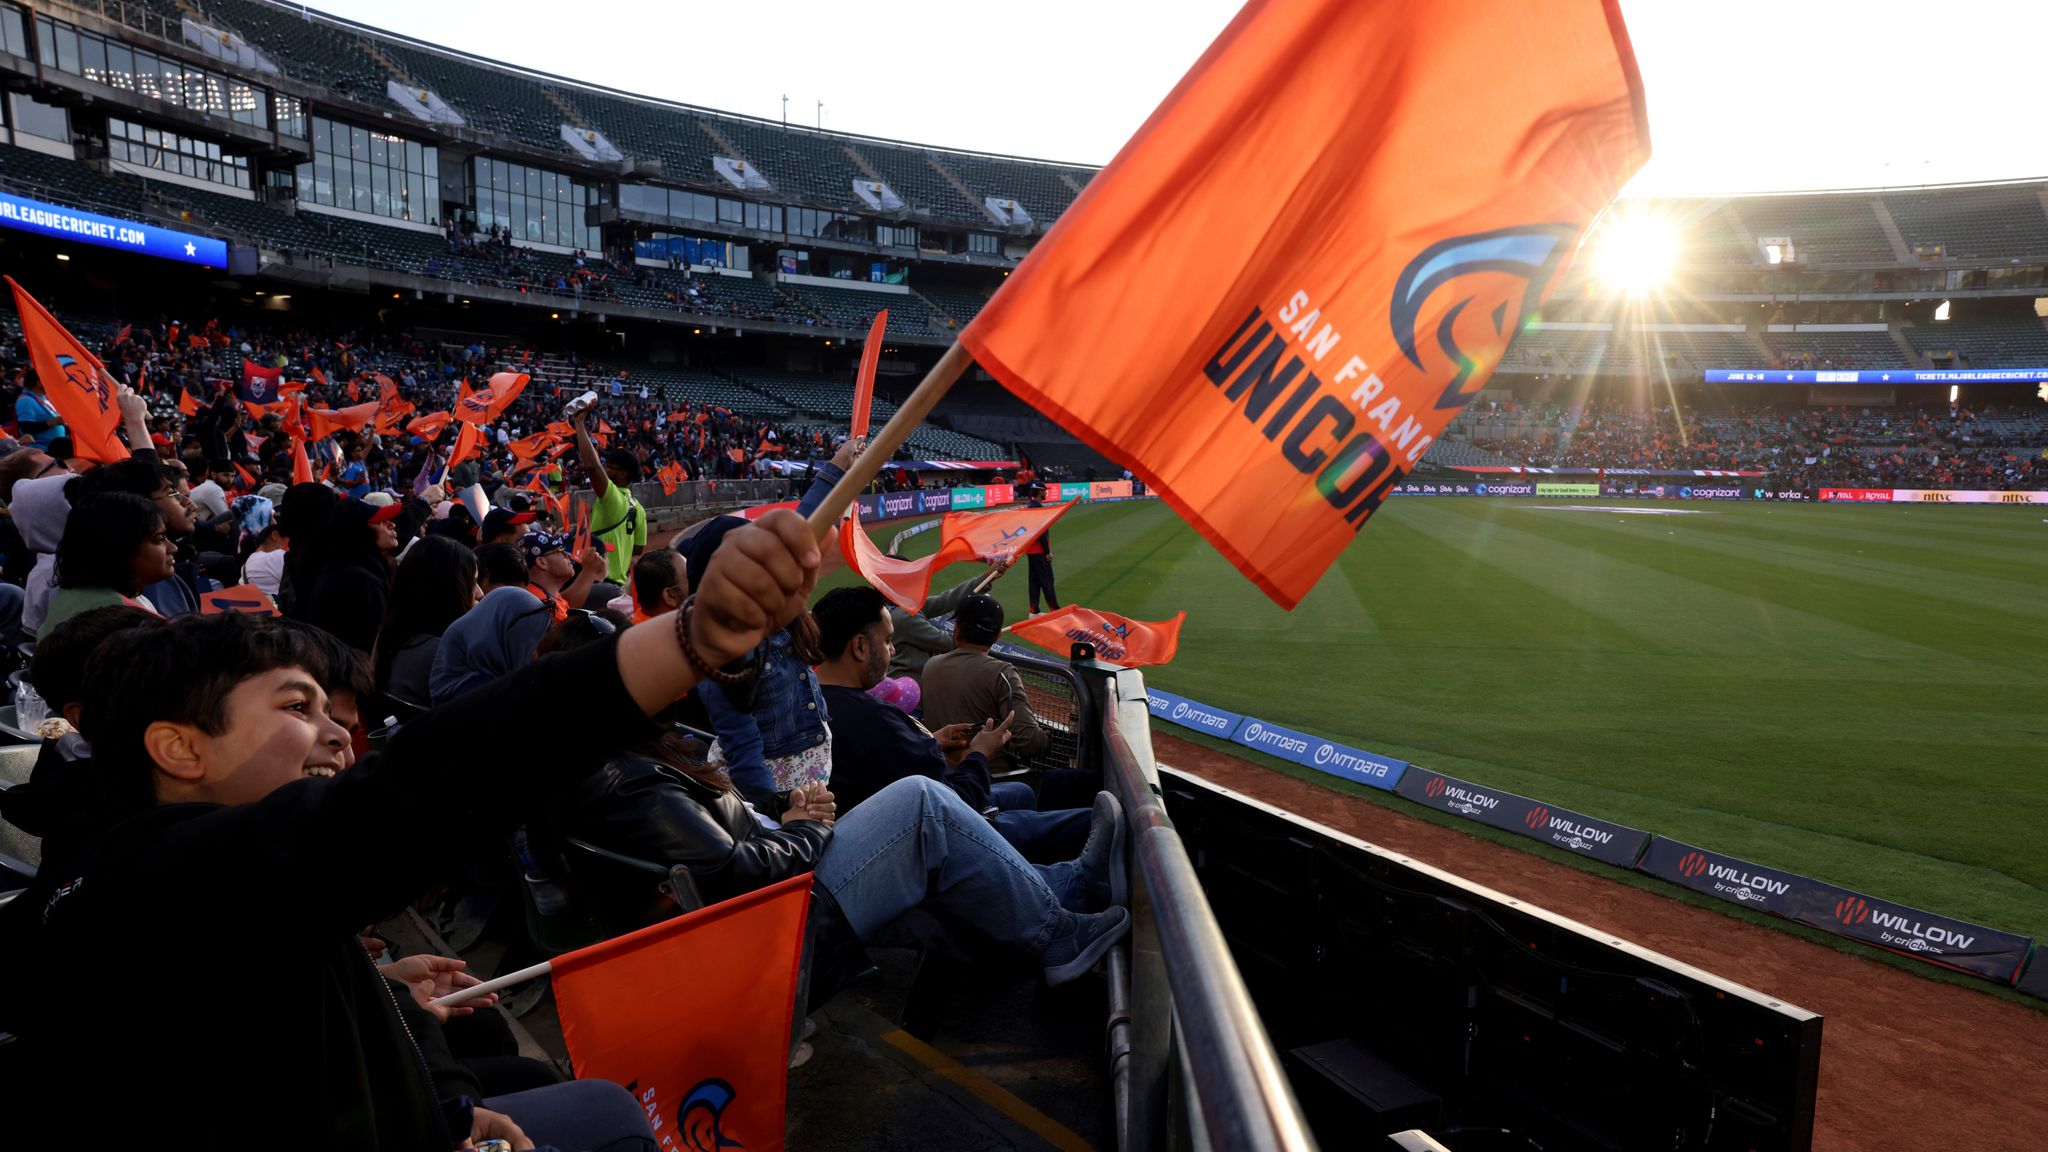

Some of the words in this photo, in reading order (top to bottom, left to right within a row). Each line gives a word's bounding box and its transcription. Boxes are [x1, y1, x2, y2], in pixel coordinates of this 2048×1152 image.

[1278, 289, 1341, 362] SAN
[1915, 371, 2048, 380] TICKETS.MAJORLEAGUECRICKET.CO
[1488, 484, 1531, 495] cognizant
[1693, 487, 1740, 498] cognizant
[1865, 492, 1890, 500] ROYAL
[886, 496, 912, 516] cognizant
[925, 492, 949, 511] cognizant
[1445, 785, 1499, 810] WILLOW
[1447, 800, 1455, 808] by
[1549, 816, 1613, 844] WILLOW
[1553, 832, 1562, 841] by
[1708, 863, 1790, 896] WILLOW
[1714, 881, 1726, 893] by
[1726, 885, 1766, 902] cricbuzz
[1872, 909, 1975, 950] WILLOW
[1880, 931, 1894, 943] by
[643, 1086, 663, 1132] SAN
